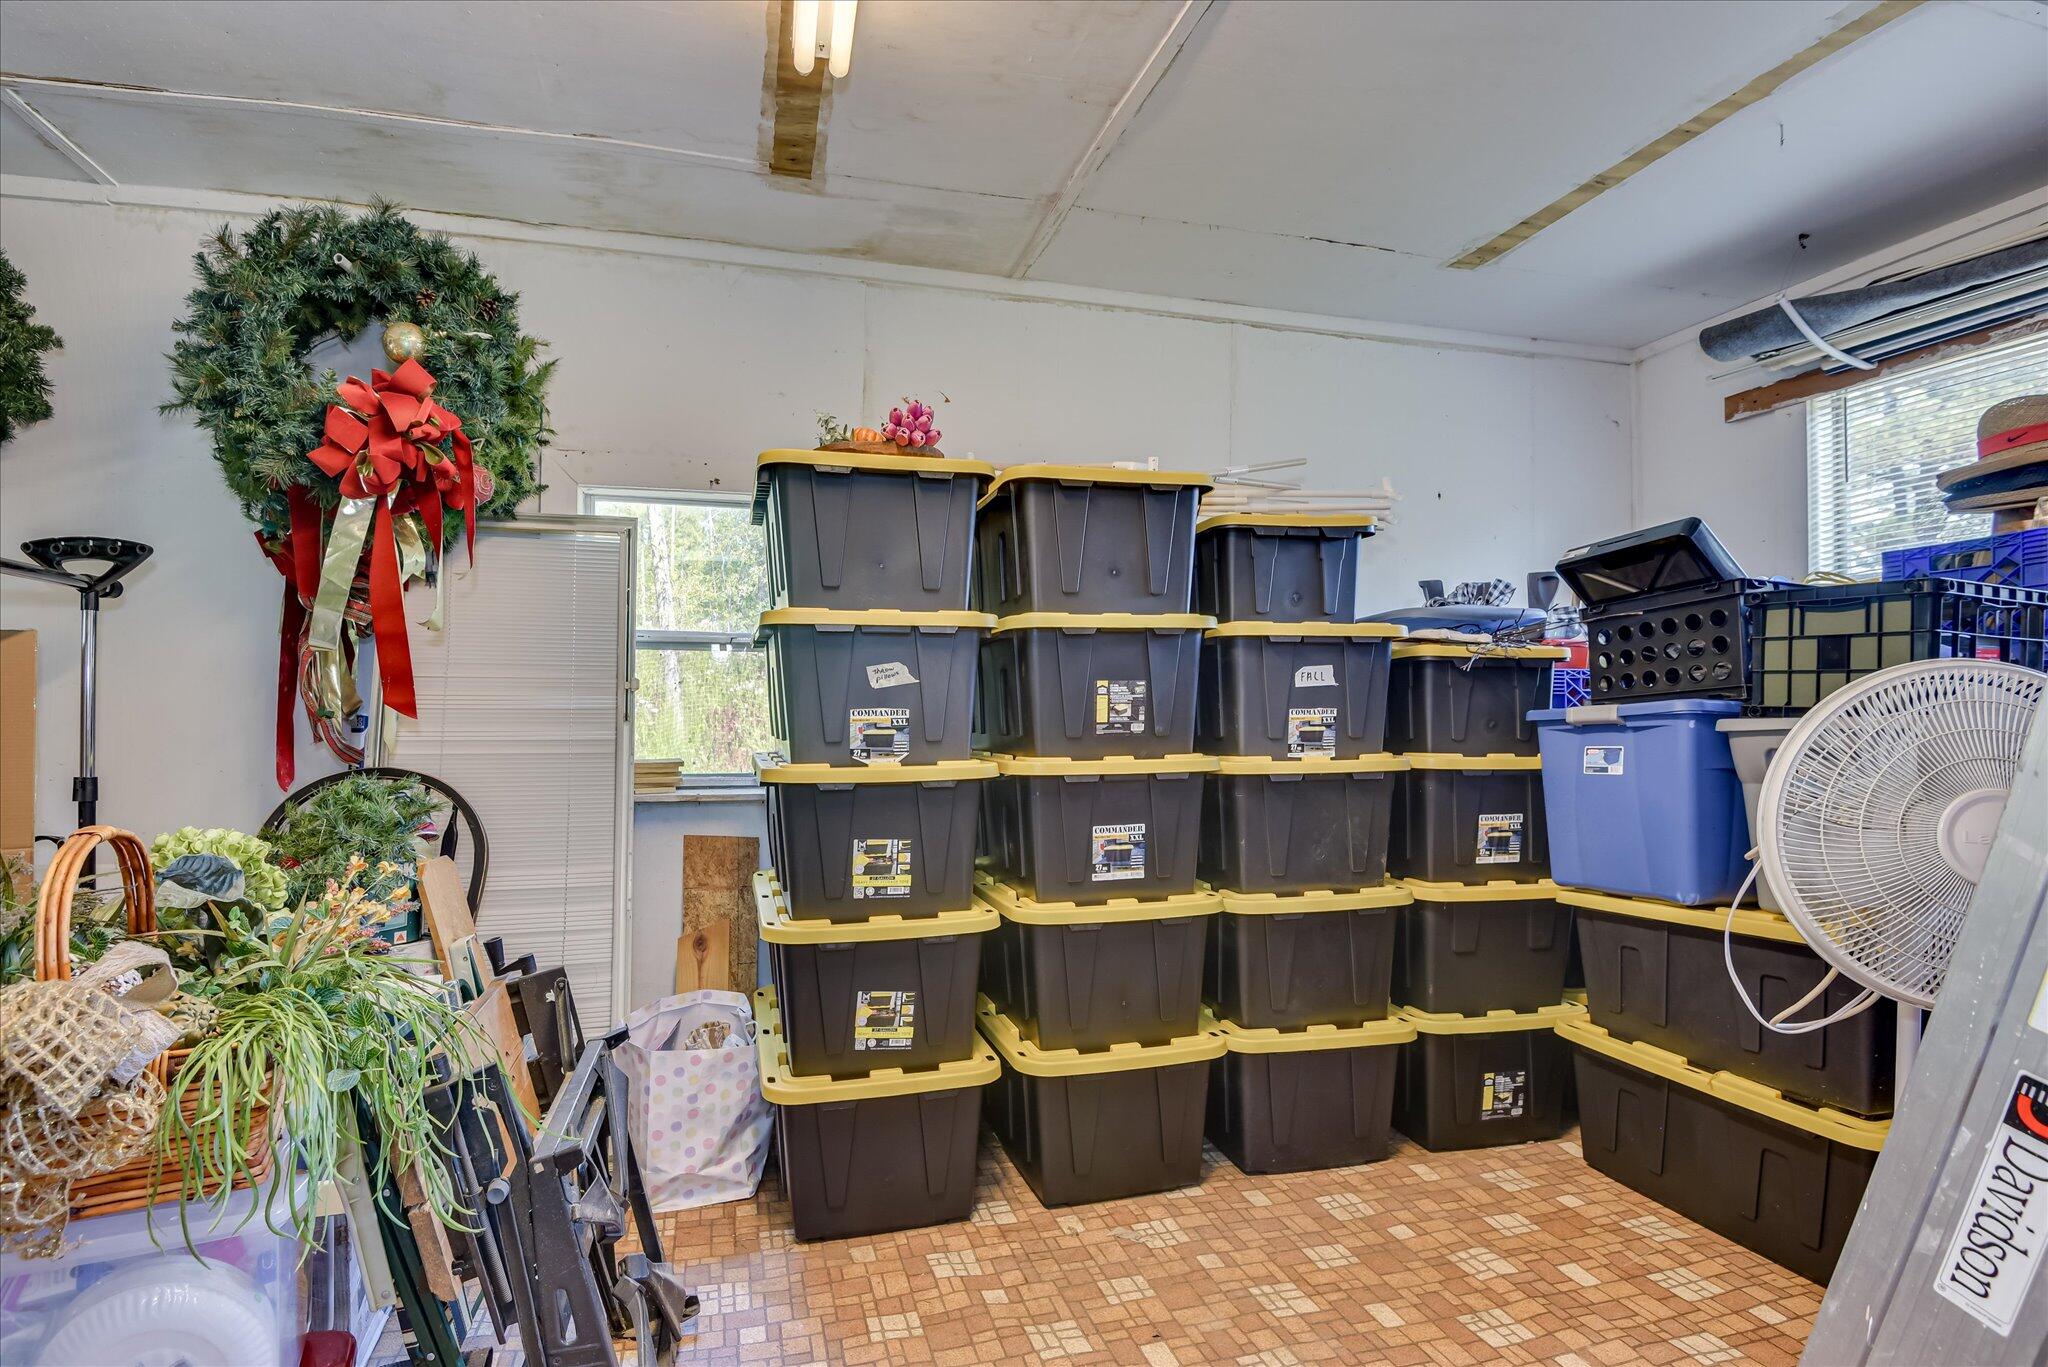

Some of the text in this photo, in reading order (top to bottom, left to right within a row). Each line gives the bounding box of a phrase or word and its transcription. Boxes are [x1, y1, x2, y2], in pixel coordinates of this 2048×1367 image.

[1301, 671, 1325, 682] FALL
[852, 709, 907, 717] COMMANDER
[892, 718, 908, 726] XXL
[1094, 825, 1143, 834] COMMANDER
[1951, 1135, 2048, 1298] Davidson
